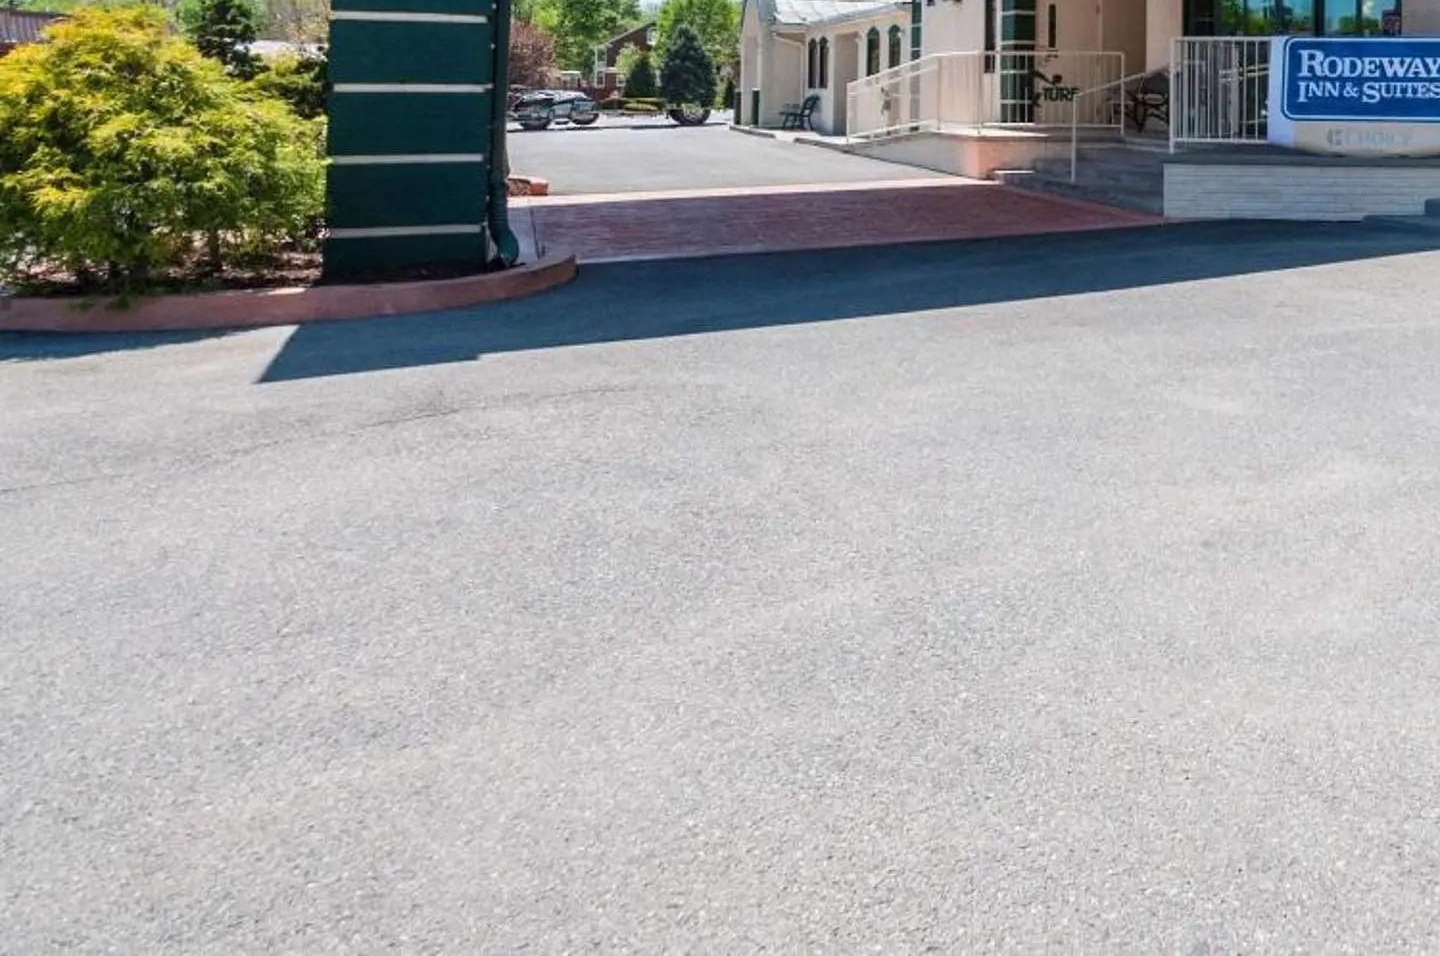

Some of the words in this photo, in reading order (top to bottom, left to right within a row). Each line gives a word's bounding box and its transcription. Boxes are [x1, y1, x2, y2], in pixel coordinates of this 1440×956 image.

[1041, 86, 1080, 102] TURF
[1297, 81, 1341, 103] INN
[1343, 82, 1360, 98] &
